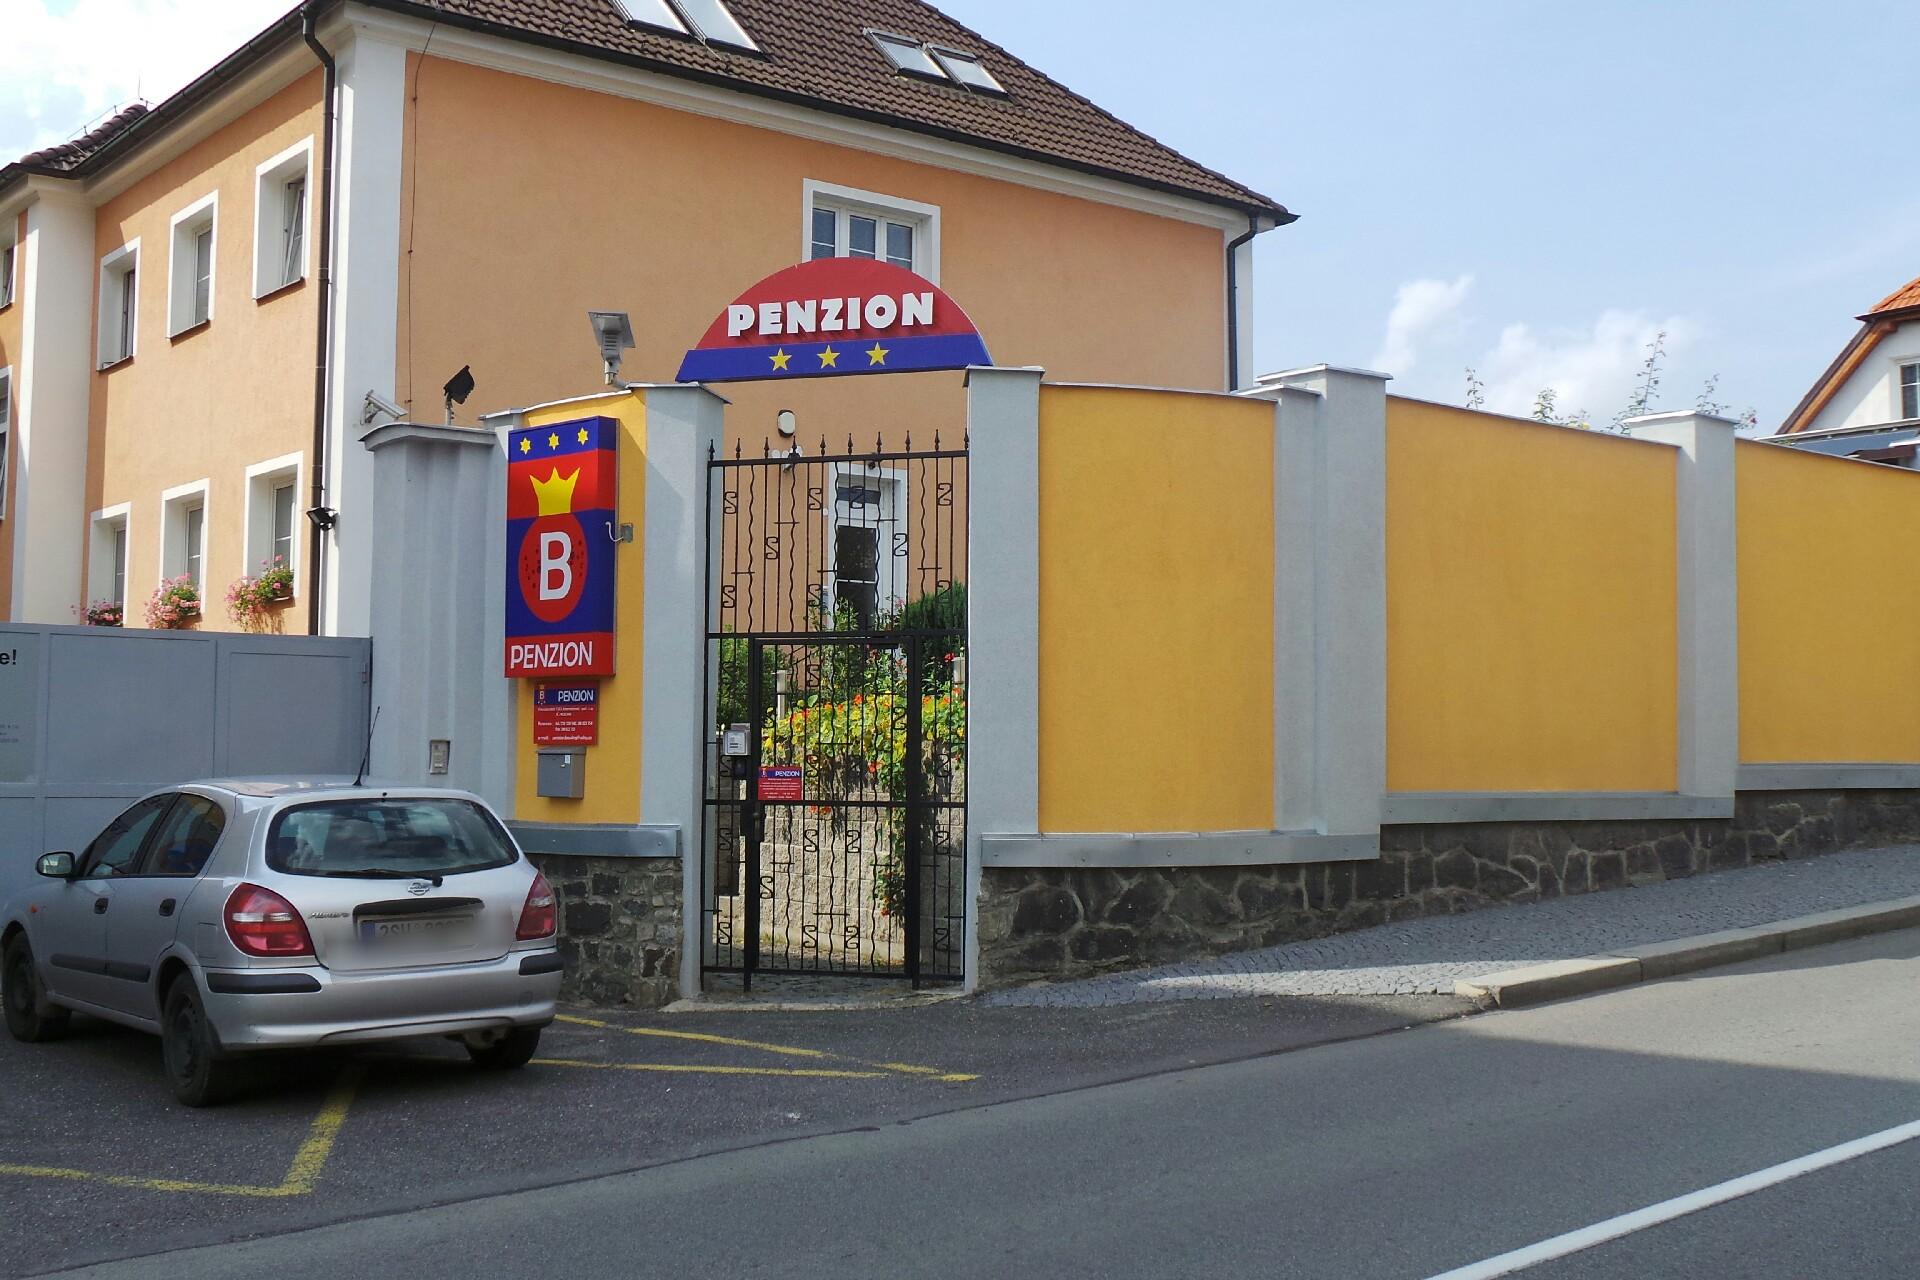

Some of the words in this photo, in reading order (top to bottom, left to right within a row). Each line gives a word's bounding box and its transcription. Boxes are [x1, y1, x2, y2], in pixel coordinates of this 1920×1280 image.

[727, 292, 933, 337] PENZION
[540, 531, 572, 600] B
[510, 641, 592, 669] PENZION
[558, 689, 594, 702] PENZION
